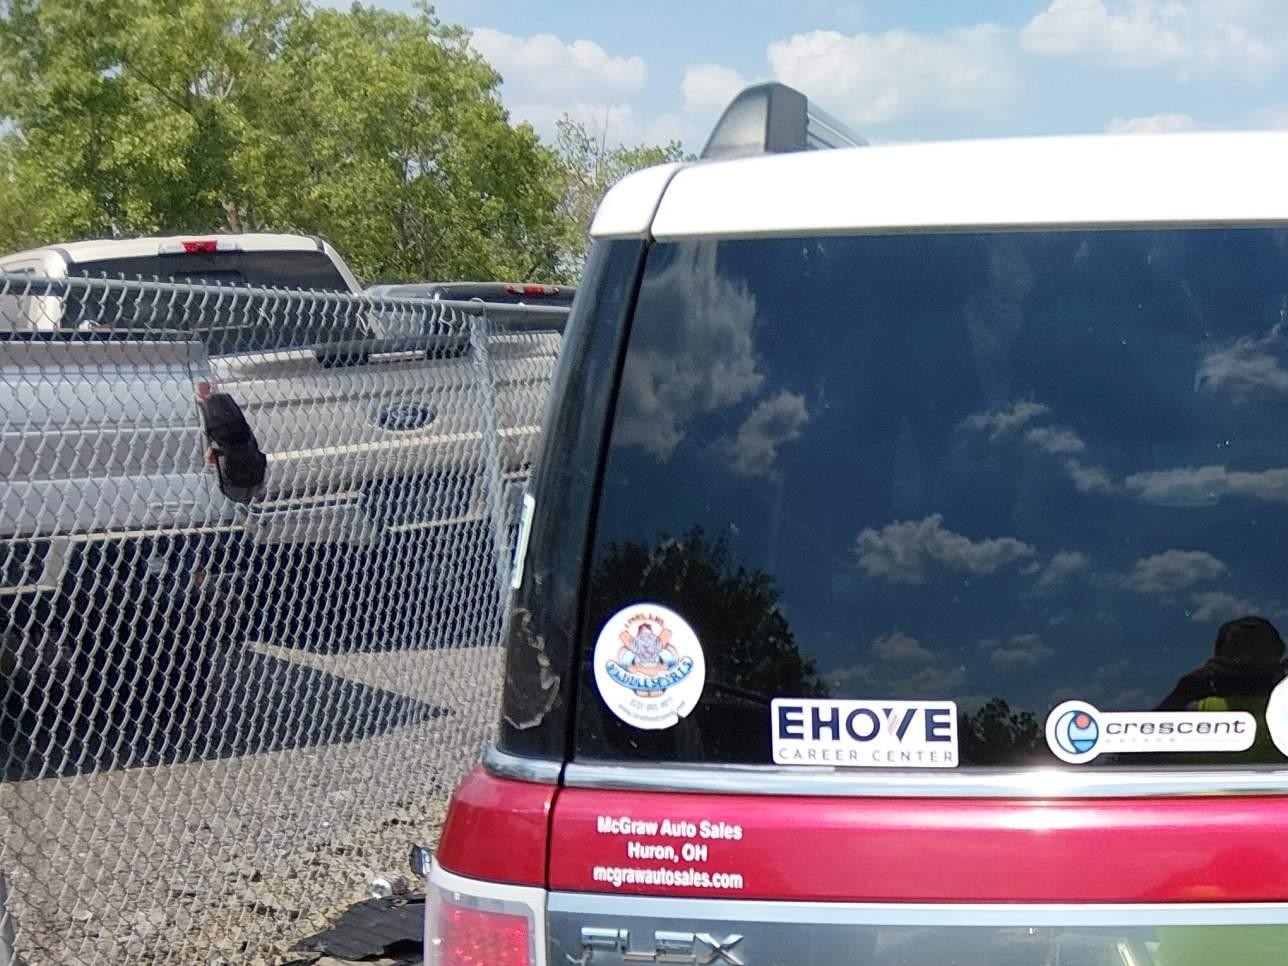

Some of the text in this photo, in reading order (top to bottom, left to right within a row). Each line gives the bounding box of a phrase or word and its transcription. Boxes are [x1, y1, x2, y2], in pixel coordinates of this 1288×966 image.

[778, 706, 952, 743] EHOVE
[1106, 720, 1246, 735] crescent
[779, 748, 953, 763] CAREER CENTER
[597, 816, 743, 840] McGraw Auto Sales
[628, 841, 708, 863] Huron, OH
[593, 866, 744, 889] mcgrawautosales.com
